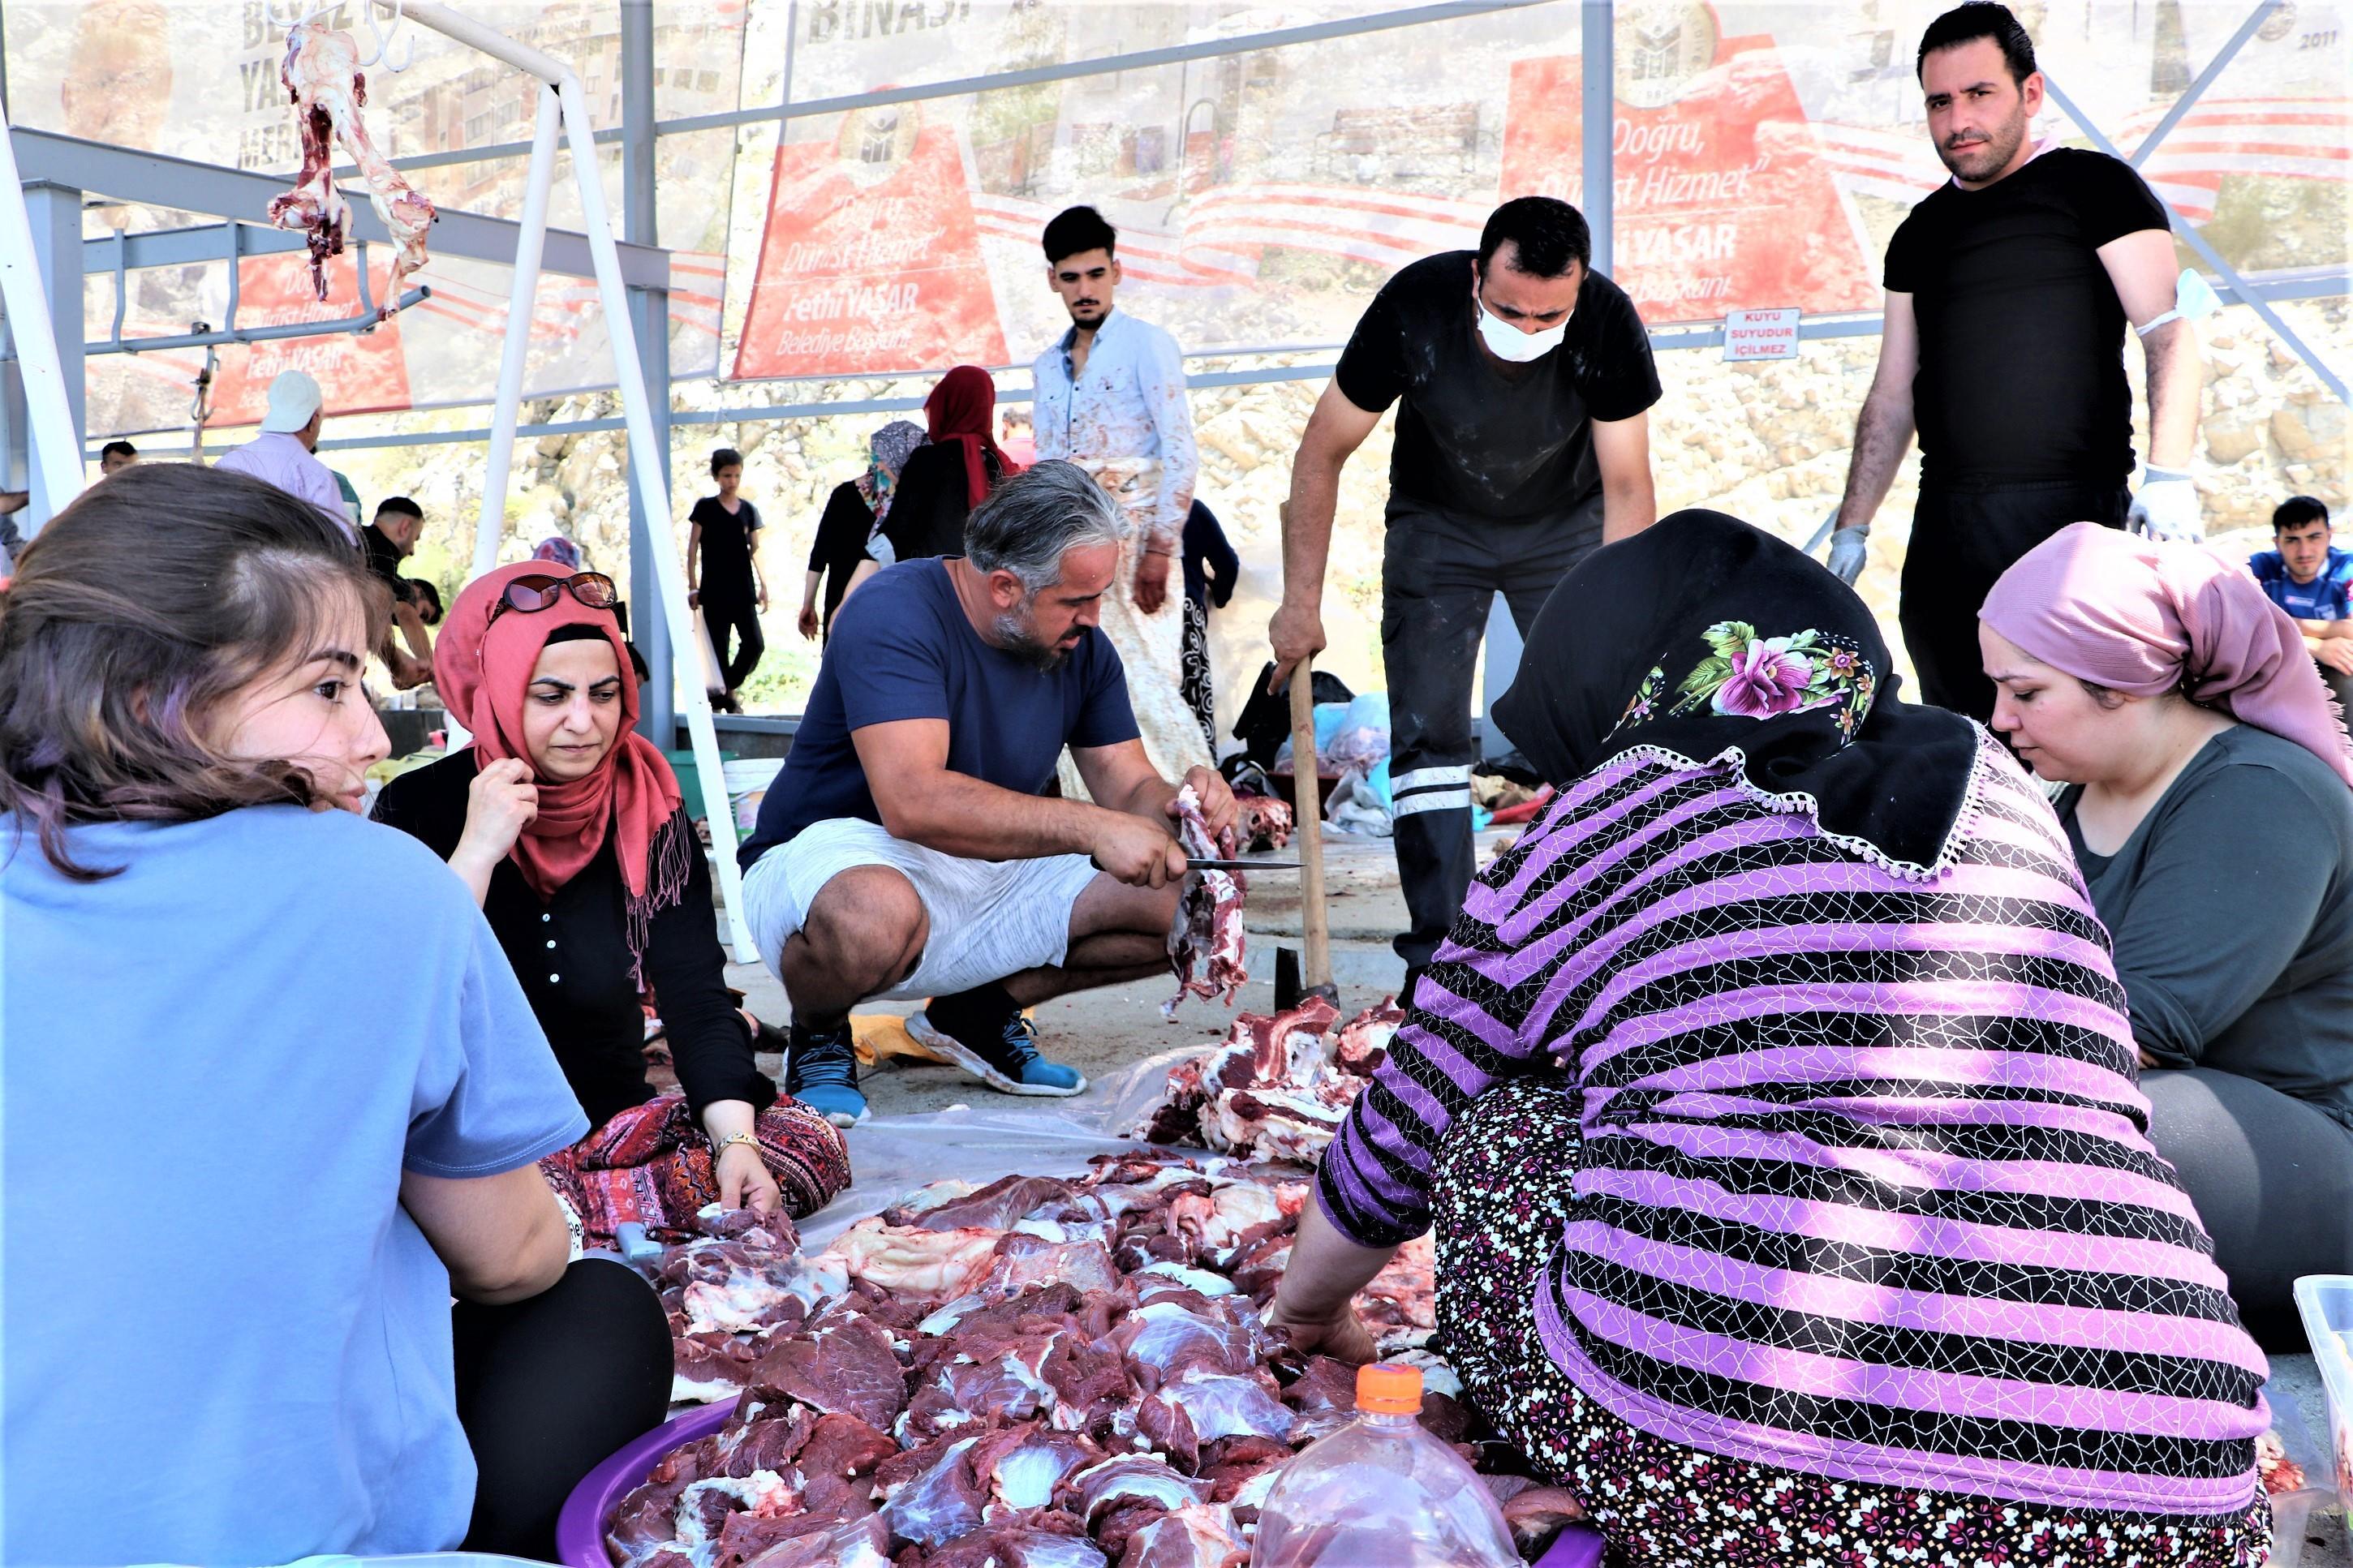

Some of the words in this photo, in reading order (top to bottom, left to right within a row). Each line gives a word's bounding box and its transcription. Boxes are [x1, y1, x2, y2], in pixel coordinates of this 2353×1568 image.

[2298, 29, 2337, 49] 2011
[1633, 224, 1738, 273] YAŞAR
[783, 288, 844, 322] Fethi
[1744, 311, 1782, 322] KUYU
[776, 326, 845, 359] Belediye
[1731, 328, 1792, 338] SUYUDUR
[1735, 344, 1787, 356] İÇİLMEZ
